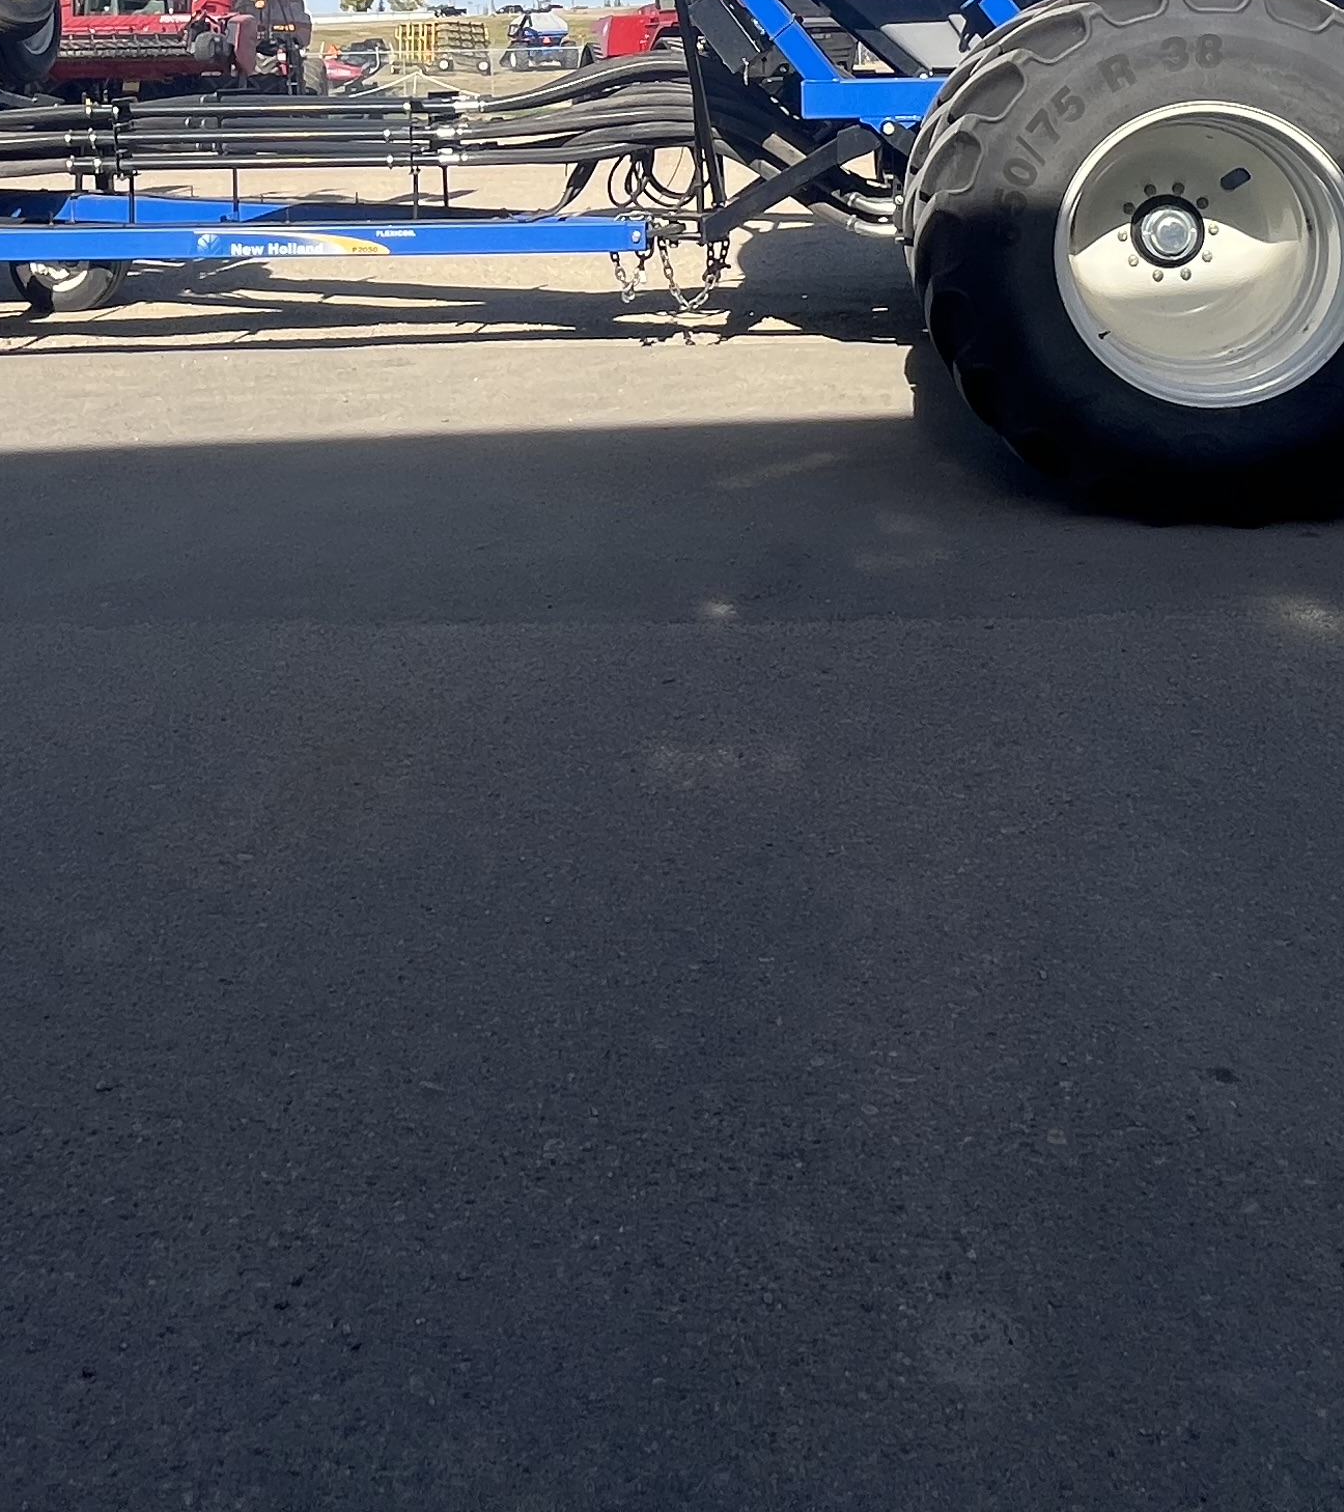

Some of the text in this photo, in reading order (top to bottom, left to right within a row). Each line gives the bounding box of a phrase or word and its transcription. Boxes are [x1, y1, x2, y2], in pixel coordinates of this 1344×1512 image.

[1096, 53, 1137, 93] R
[1159, 33, 1224, 73] 38
[230, 243, 264, 256] New
[268, 242, 324, 255] Holland
